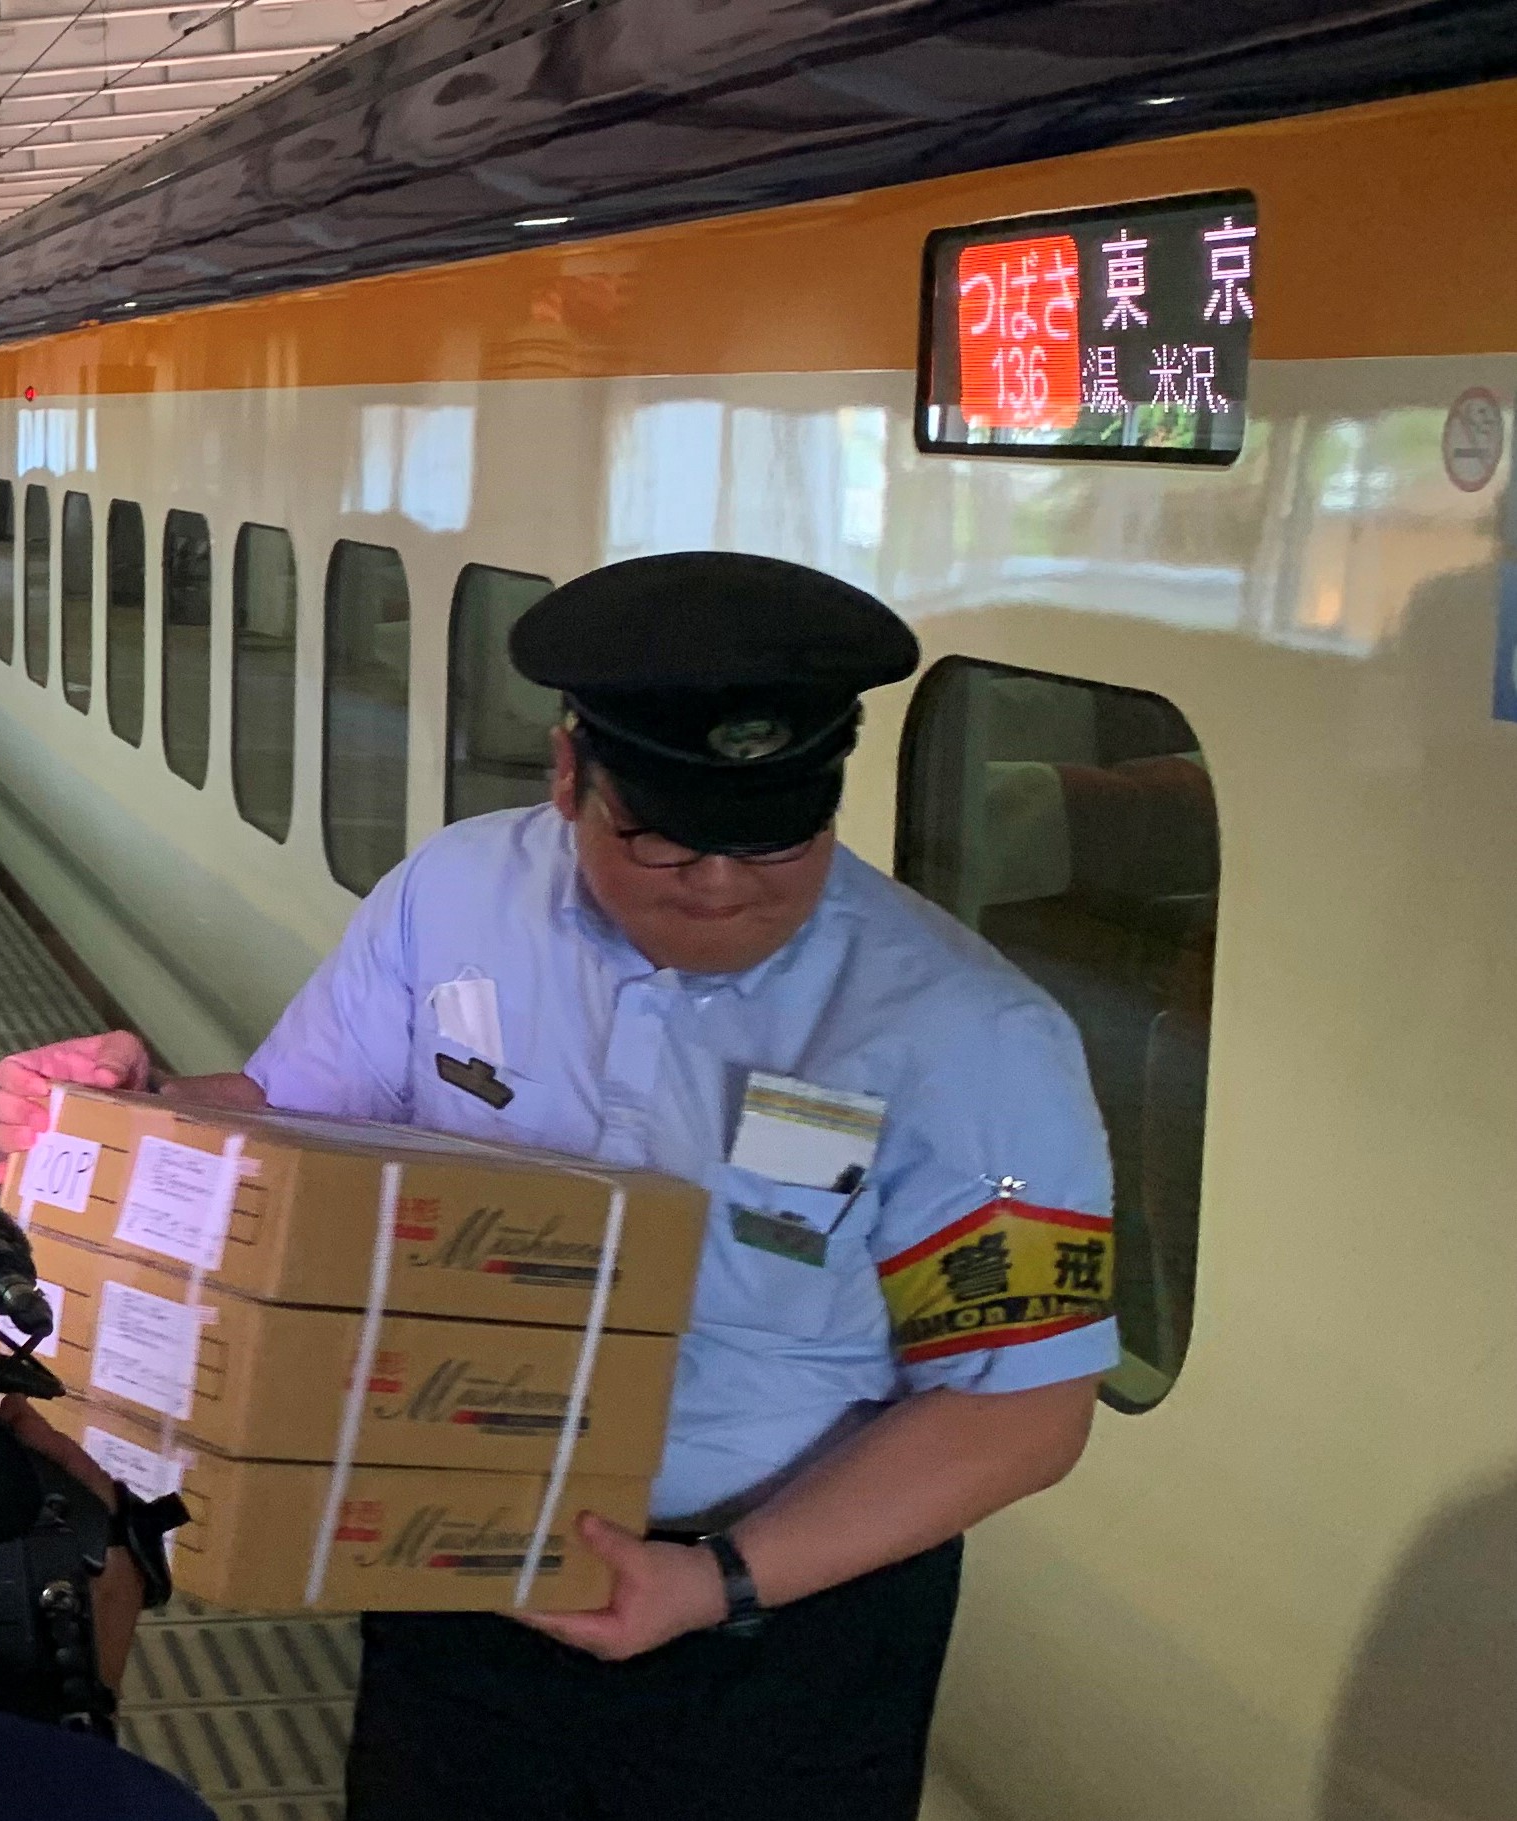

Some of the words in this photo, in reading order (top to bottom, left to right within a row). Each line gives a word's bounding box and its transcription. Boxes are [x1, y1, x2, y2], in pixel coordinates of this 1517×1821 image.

[960, 249, 1076, 341] つばさ
[1101, 215, 1258, 331] 東京
[992, 345, 1049, 408] 136
[1148, 343, 1230, 414] 米沢
[939, 1230, 1107, 1302] 警戒
[953, 1305, 1007, 1329] On
